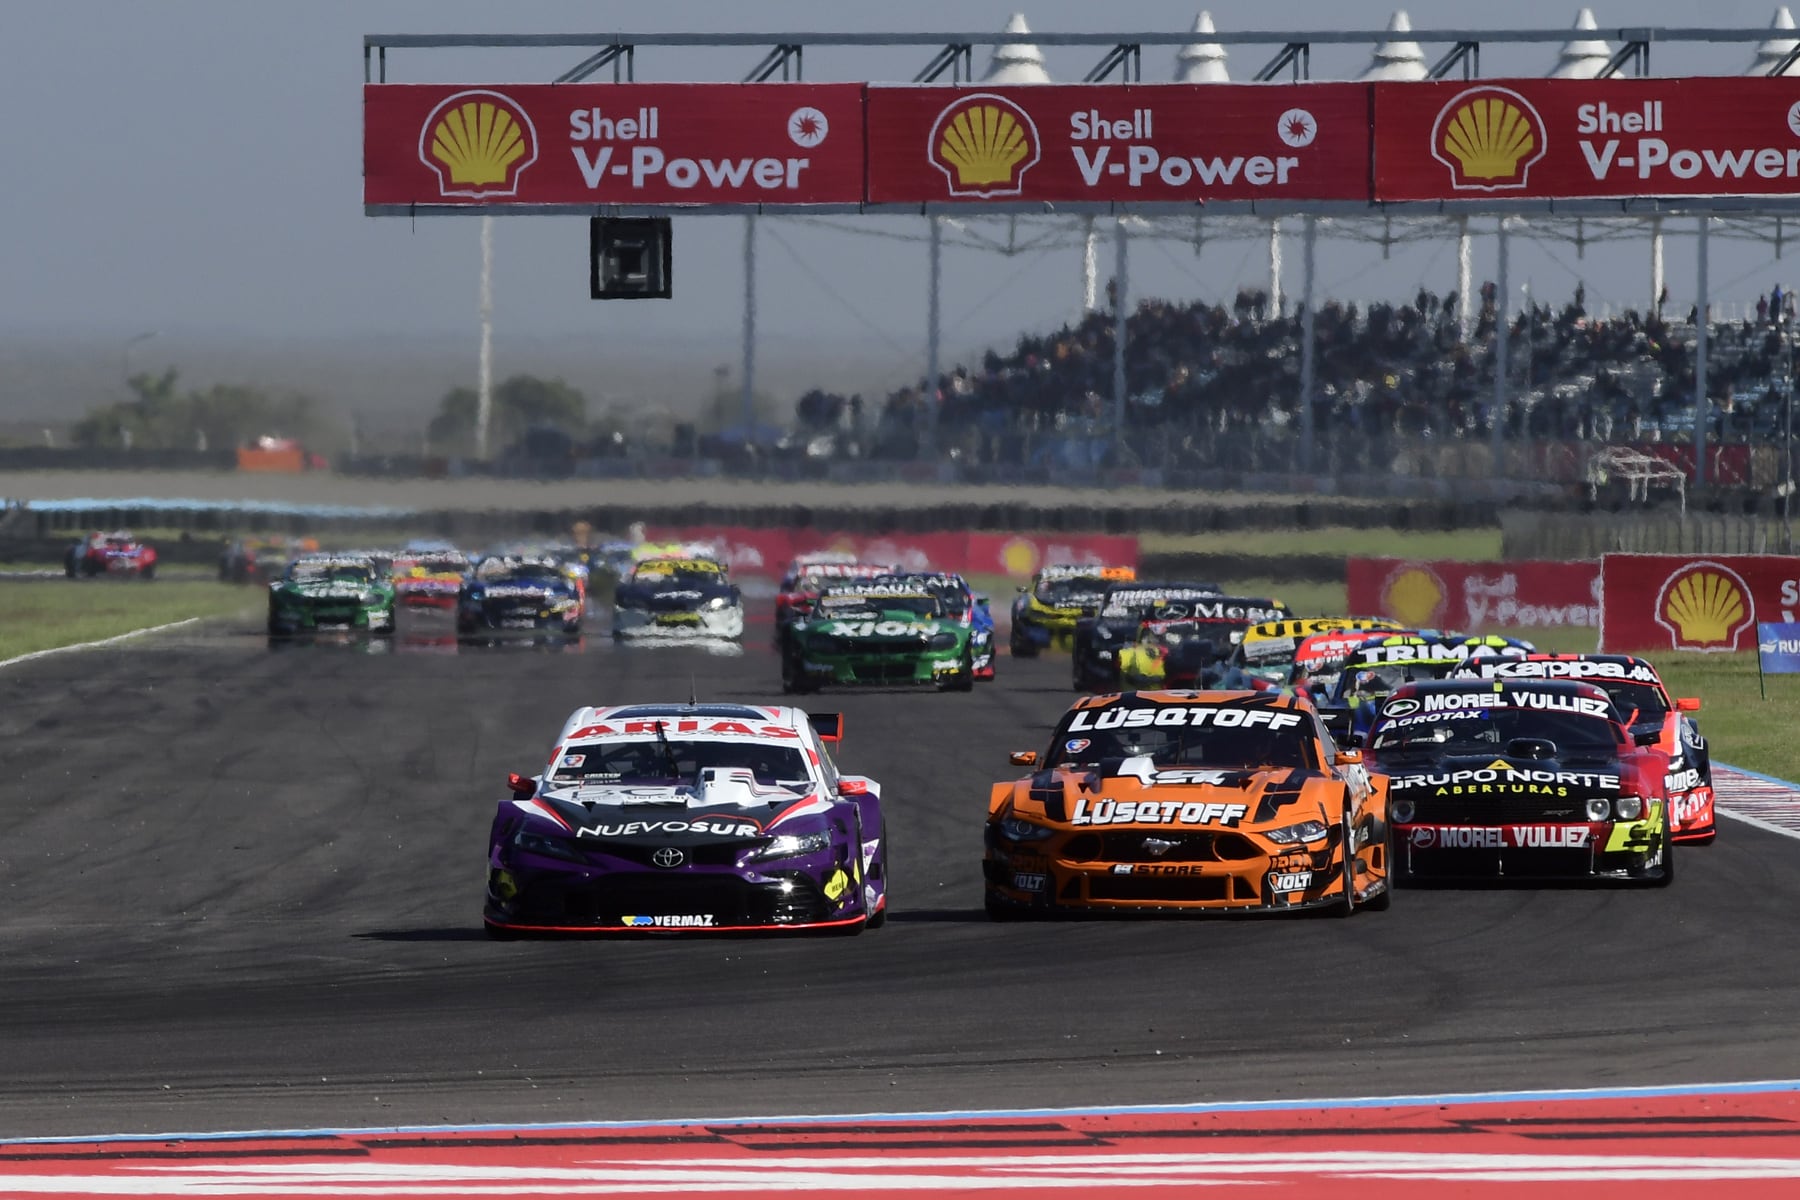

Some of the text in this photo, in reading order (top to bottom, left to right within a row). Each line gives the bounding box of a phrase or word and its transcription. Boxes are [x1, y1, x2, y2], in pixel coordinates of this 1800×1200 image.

[569, 107, 659, 140] Shell
[1069, 108, 1153, 140] Shell
[1577, 101, 1663, 134] Shell
[570, 145, 811, 189] V-Power
[1070, 144, 1299, 187] V-Power
[1578, 137, 1800, 181] V-Power
[829, 621, 940, 637] XION
[1481, 661, 1627, 679] Kappa
[1424, 691, 1609, 718] MOREL VULLIEZ
[567, 719, 801, 740] ARIAS
[1067, 706, 1301, 732] LÜSQTOFF
[1379, 711, 1482, 732] AGROTAX
[1507, 769, 1620, 789] NORTE
[1436, 784, 1568, 797] ABERTURAS
[1072, 799, 1247, 825] LÜSQTOFF
[576, 821, 758, 838] NUEVOSUR
[1440, 826, 1590, 848] MOREL VULLIEZ
[1137, 865, 1204, 875] STORE
[653, 915, 714, 927] VERMAZ
